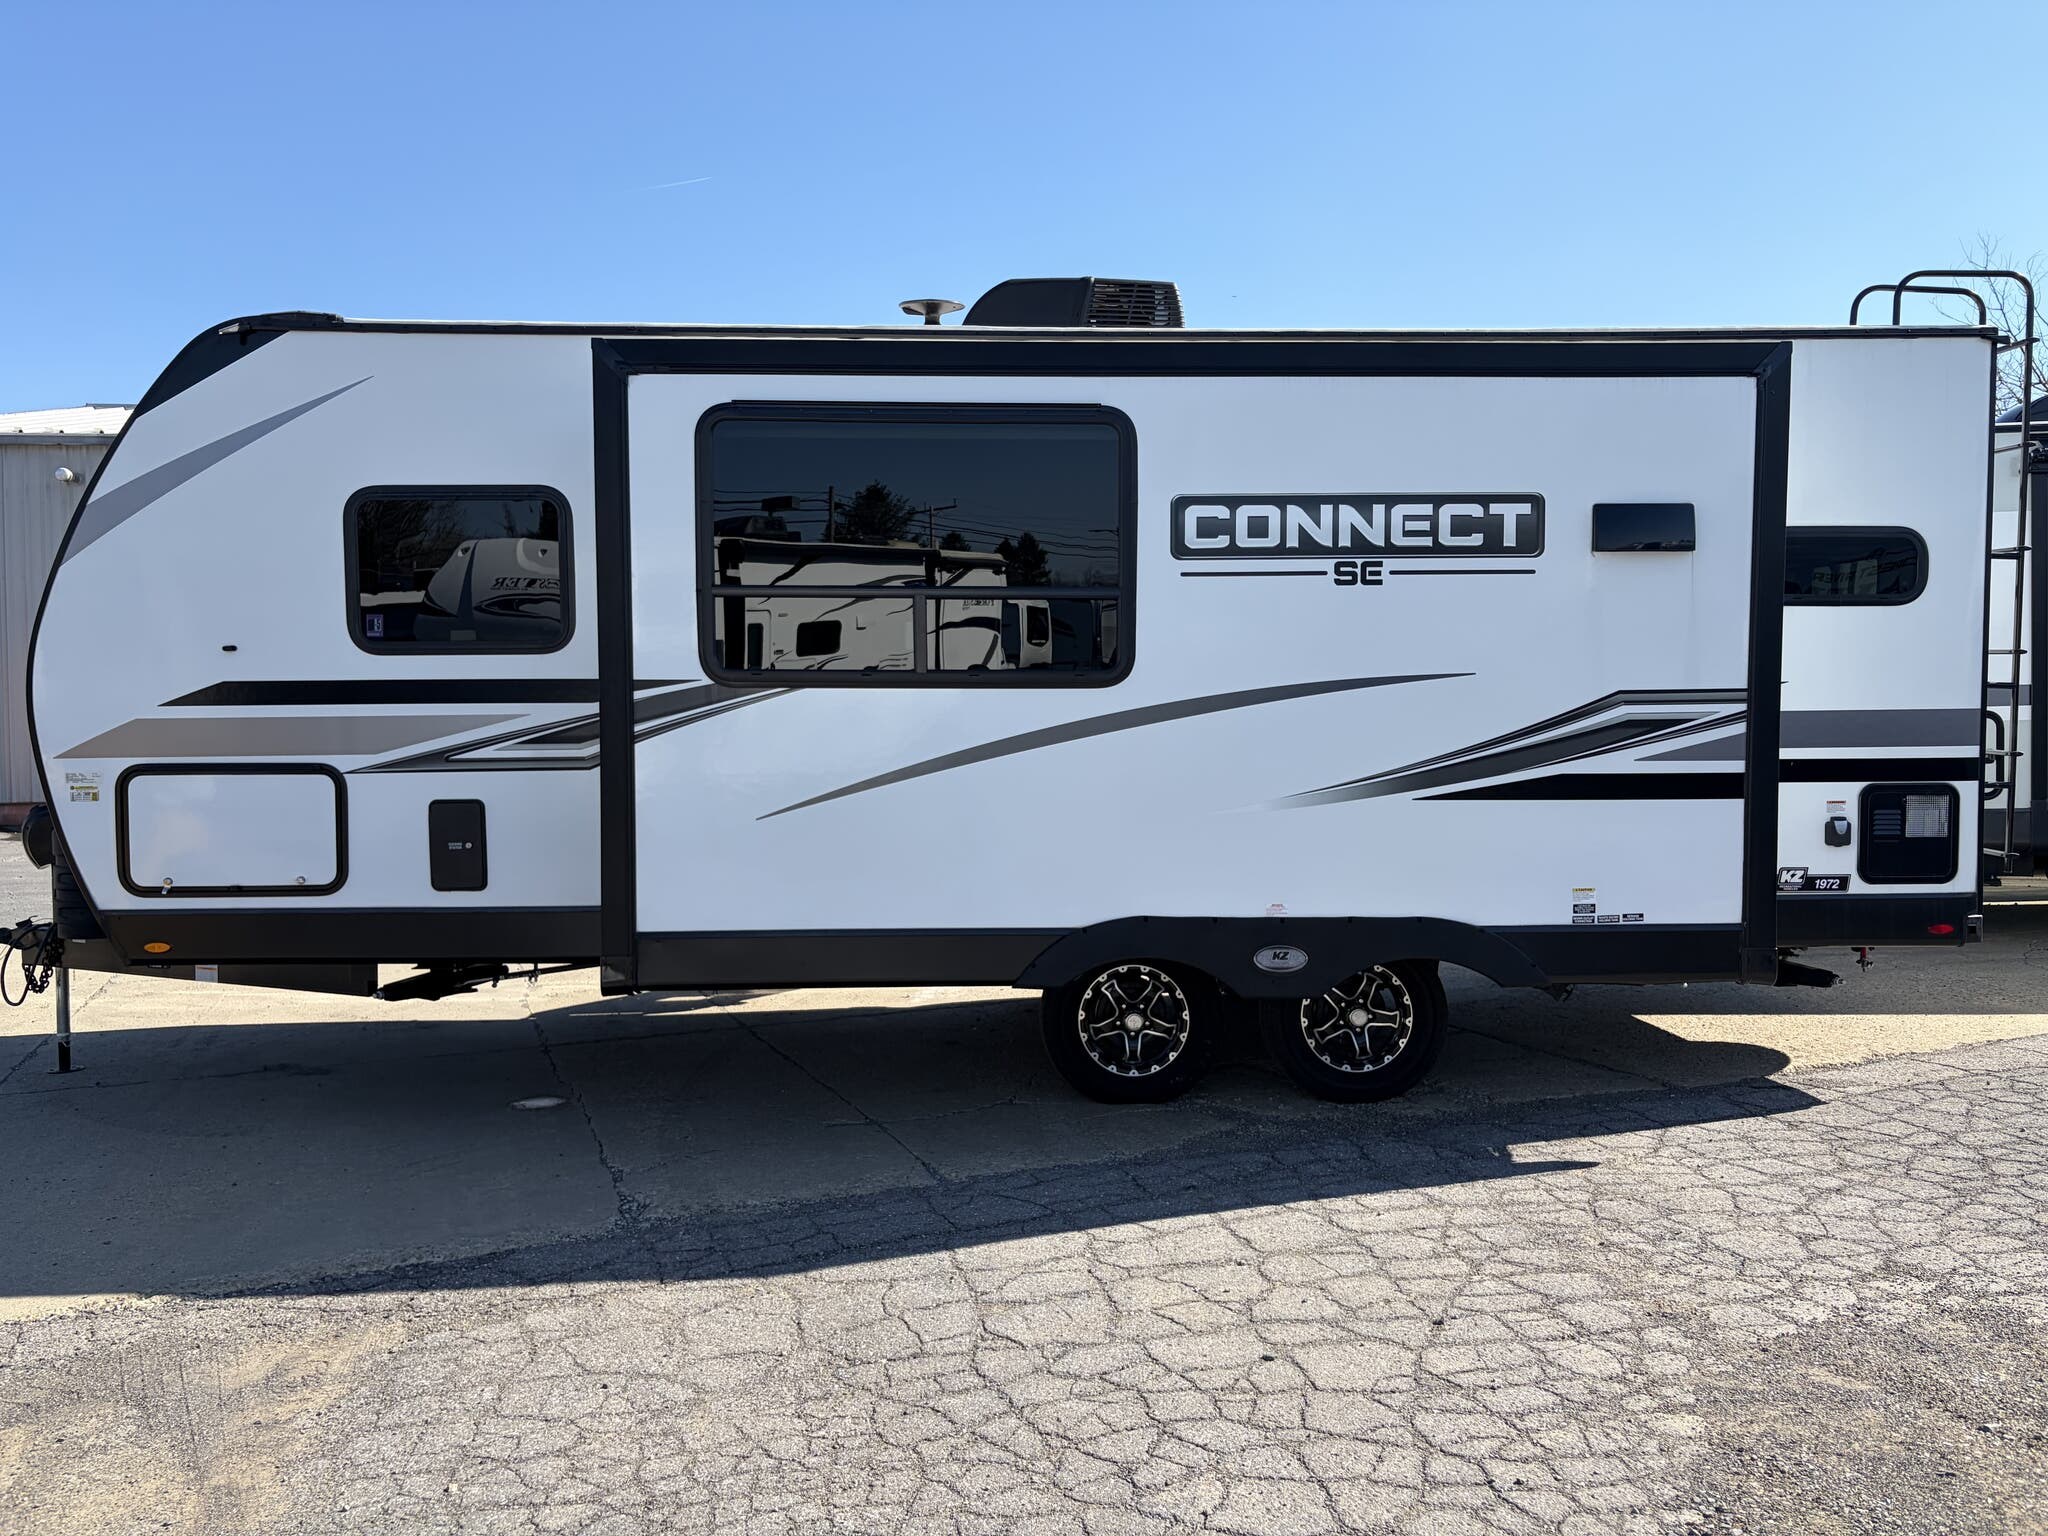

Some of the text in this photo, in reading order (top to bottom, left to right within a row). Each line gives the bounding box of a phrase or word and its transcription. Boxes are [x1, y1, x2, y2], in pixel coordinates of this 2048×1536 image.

[1184, 503, 1532, 549] CONNECT
[1333, 560, 1384, 586] SE
[1780, 870, 1805, 883] KZ
[1815, 879, 1840, 889] 1972
[1272, 951, 1290, 960] KZ
